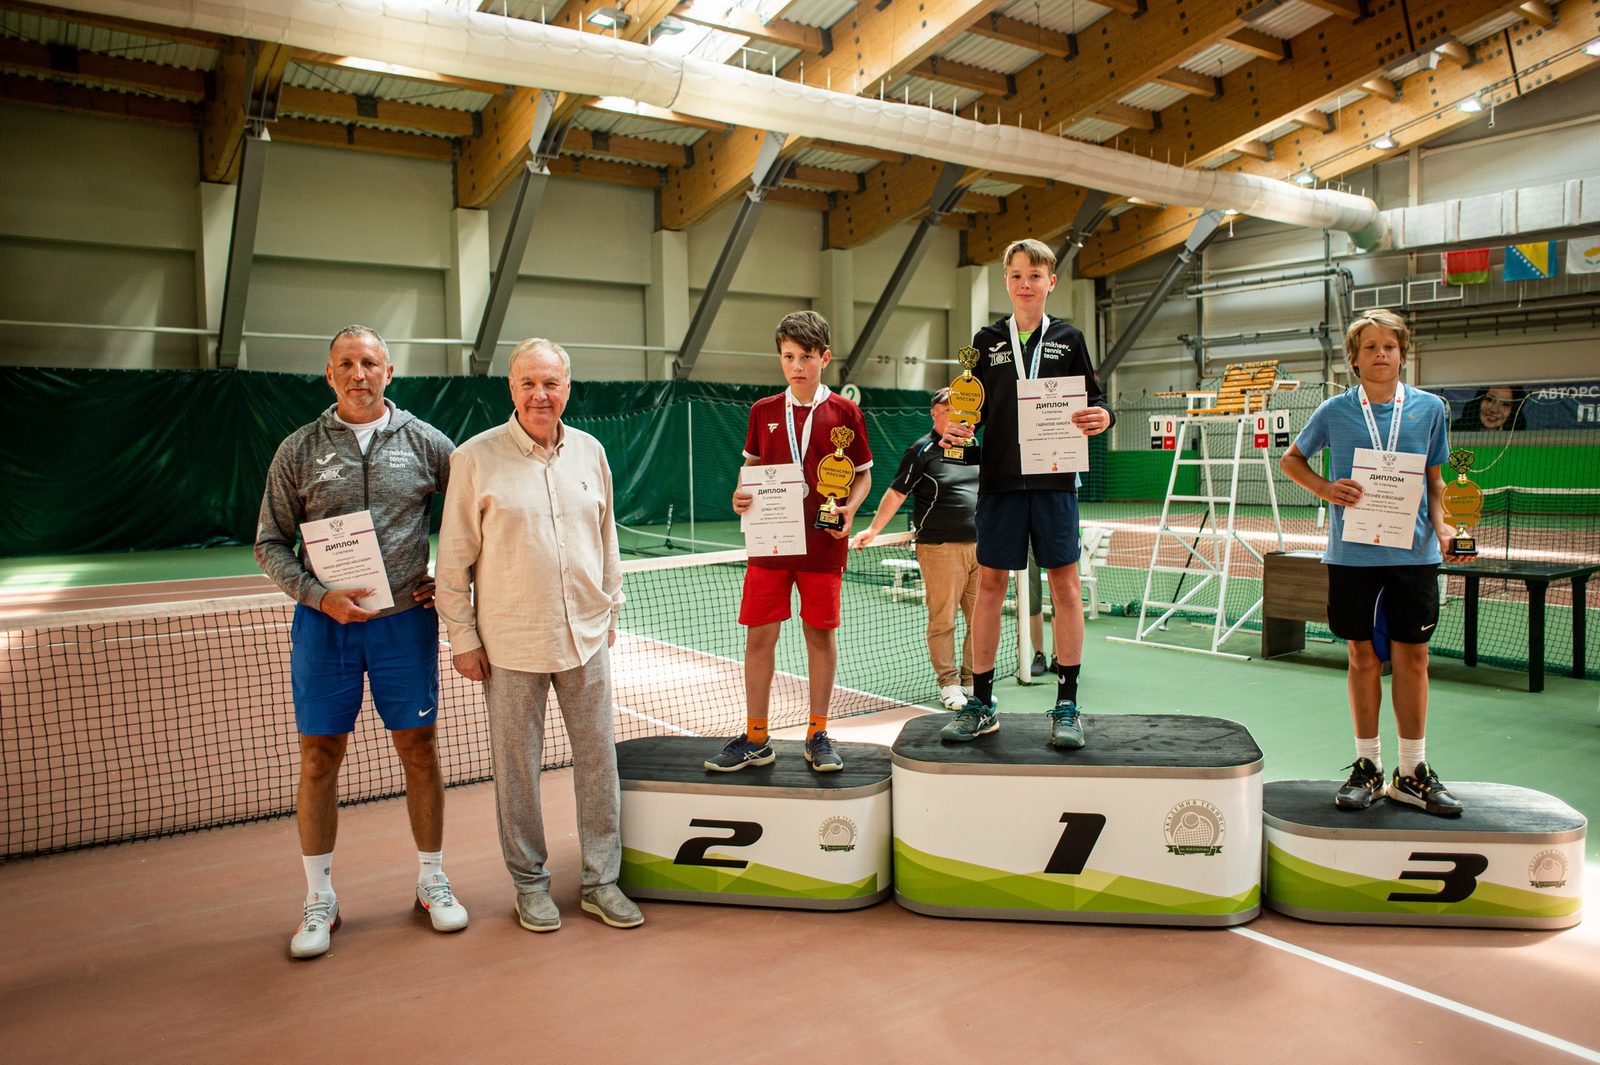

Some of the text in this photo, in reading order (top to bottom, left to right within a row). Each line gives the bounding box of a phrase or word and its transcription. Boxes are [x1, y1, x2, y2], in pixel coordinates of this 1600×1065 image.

[1036, 401, 1069, 410] ДИПЛОМ
[1166, 420, 1173, 433] 0
[1257, 417, 1265, 430] 0
[1277, 416, 1284, 429] 0
[1369, 474, 1405, 483] ДИПЛОМ
[757, 487, 787, 496] ДИПЛОМ
[325, 538, 360, 552] ДИПЛОМ
[672, 818, 764, 869] 2
[1043, 811, 1107, 875] 1
[1387, 851, 1489, 903] 3
